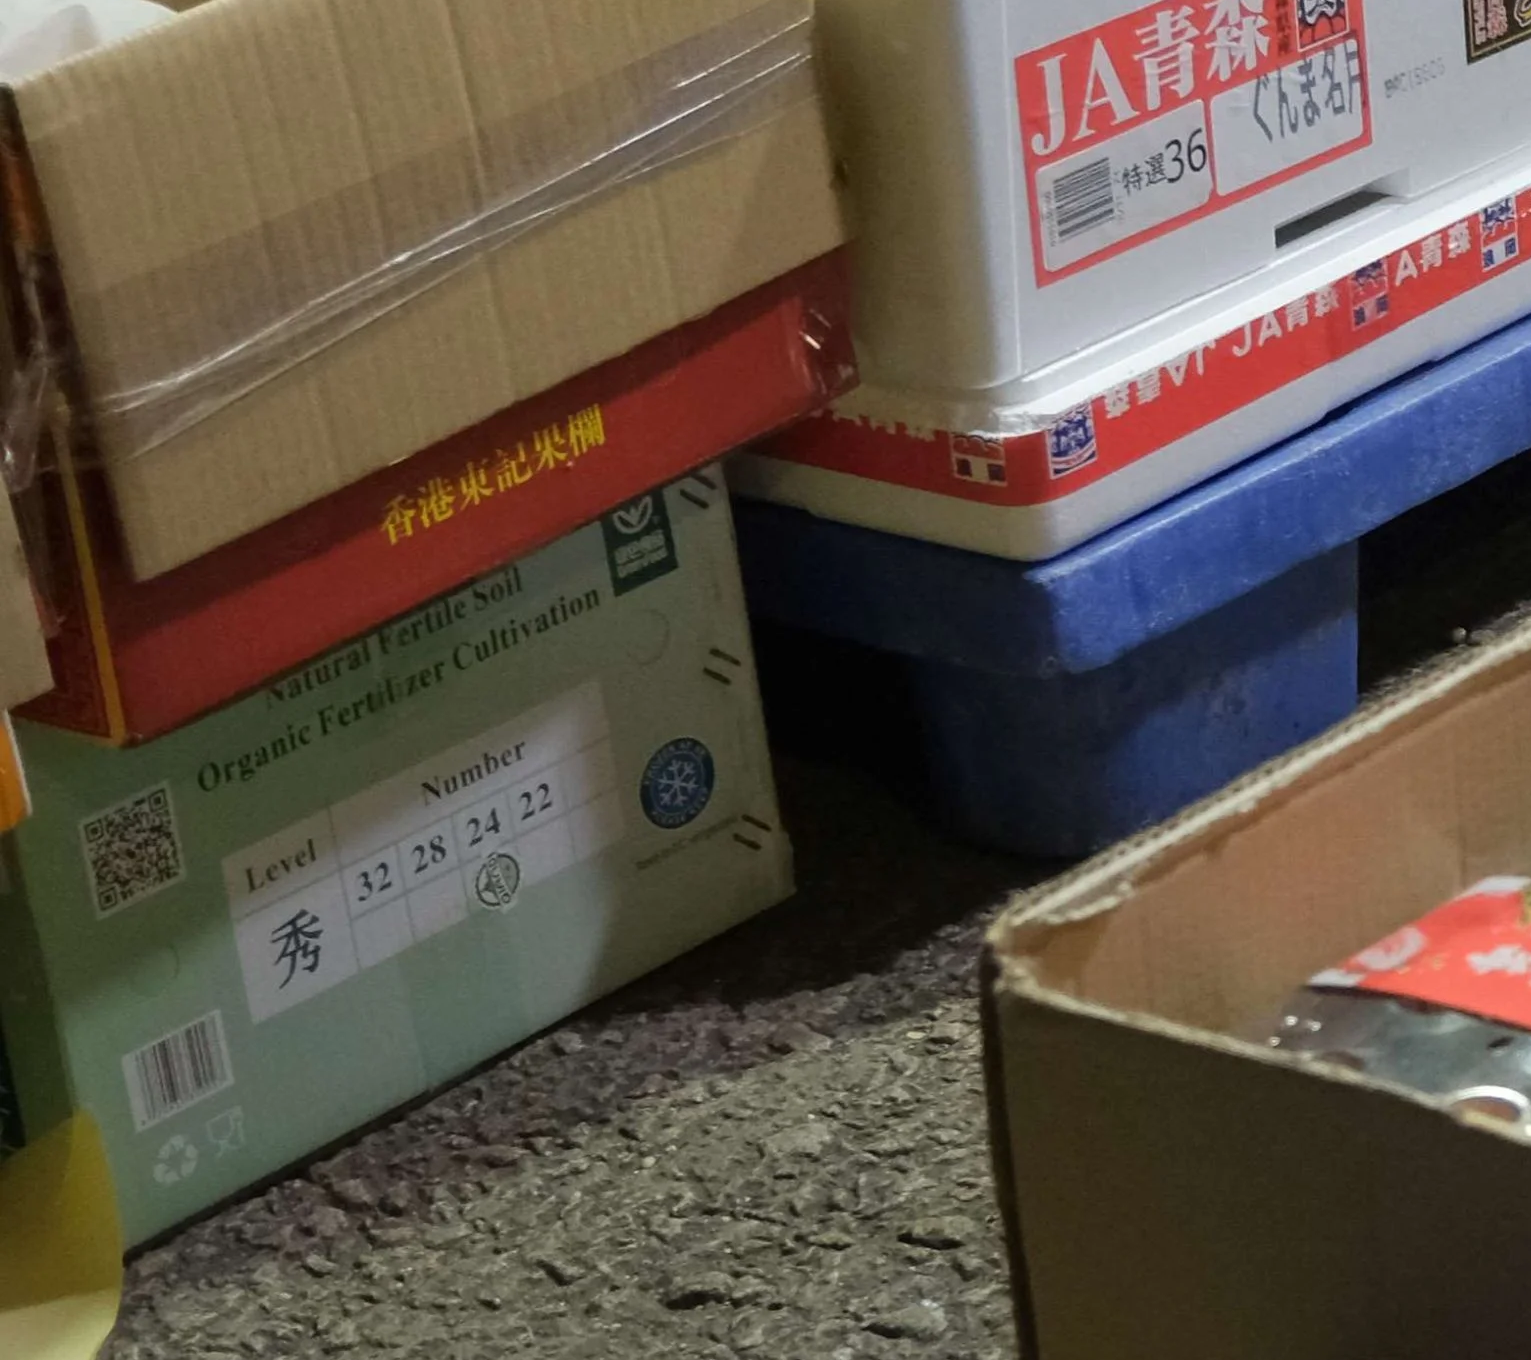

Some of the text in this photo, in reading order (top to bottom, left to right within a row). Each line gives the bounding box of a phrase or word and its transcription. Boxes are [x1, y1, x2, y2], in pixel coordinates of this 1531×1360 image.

[377, 589, 468, 657] Fertile
[472, 565, 524, 615] Soil
[197, 719, 312, 795] Organic
[451, 587, 600, 673] Cultivation
[422, 740, 527, 807] Number
[245, 838, 318, 894] Level
[357, 781, 553, 903] 32 28 24 22
[271, 906, 325, 990] 秀
